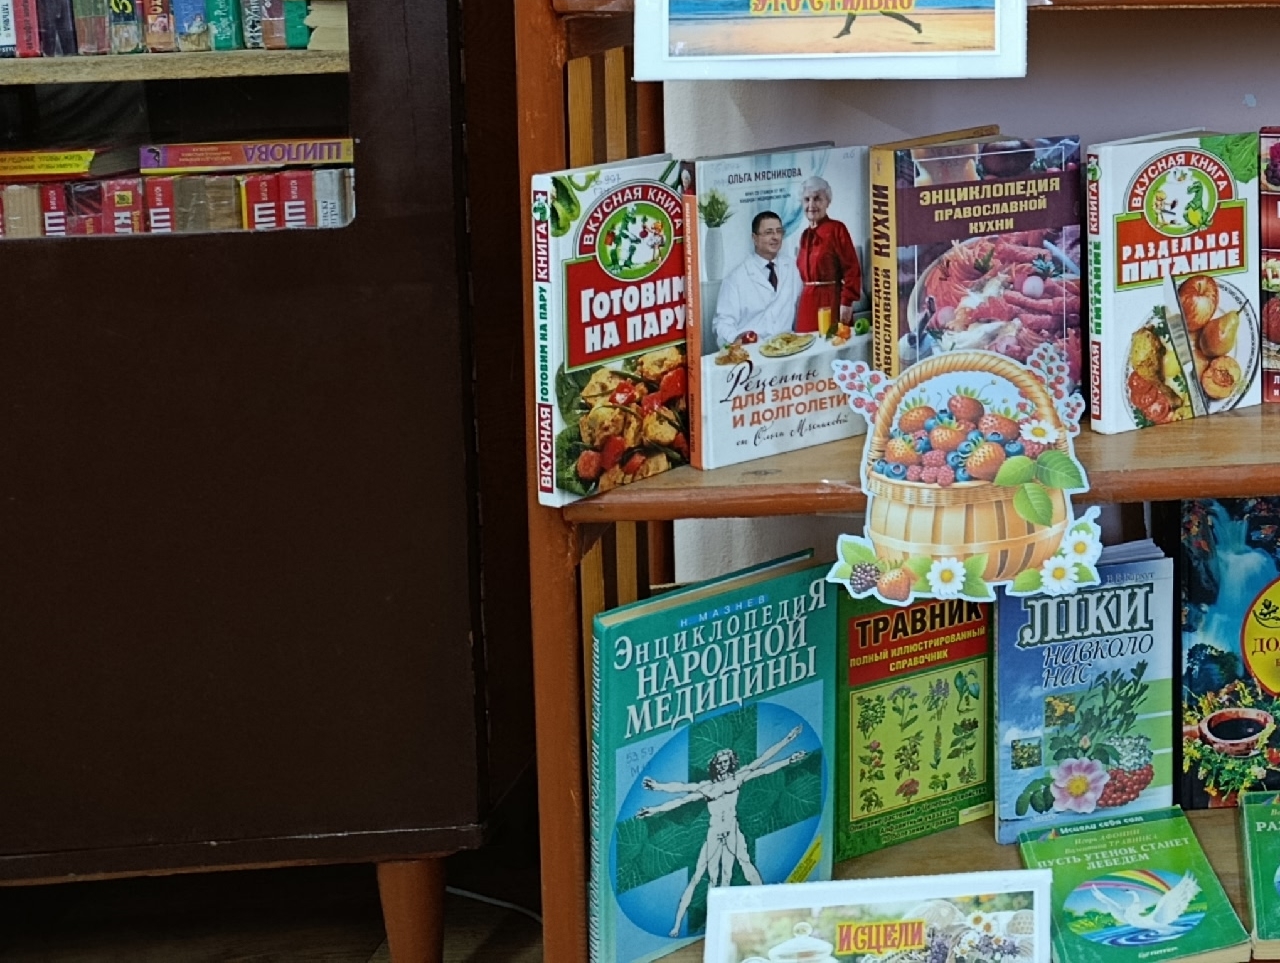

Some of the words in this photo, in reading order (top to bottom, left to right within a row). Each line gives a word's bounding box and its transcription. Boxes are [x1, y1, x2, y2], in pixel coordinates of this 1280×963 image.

[244, 142, 342, 163] ШИЛОВА
[919, 177, 1060, 206] ЭНЦИКЛОПЕДИЯ
[1131, 151, 1188, 208] ВКУСНАЯ
[1190, 152, 1228, 193] КНИГА
[872, 184, 891, 258] КУХНИ
[934, 196, 1047, 223] ПРАВОСЛАВНОЙ
[1089, 182, 1098, 233] КНИГА
[969, 218, 1014, 234] КУХНИ
[535, 224, 548, 280] КНИГА
[1122, 231, 1240, 260] РАЗДЕЛЬНОЕ
[1122, 250, 1240, 283] ПИТАНИЕ
[580, 275, 686, 324] ГОТОВИМ
[584, 321, 621, 354] НА
[627, 305, 686, 342] ПАРУ
[539, 343, 549, 402] ГОТОВИМ
[1091, 343, 1100, 417] ВКУСНАЯ
[731, 392, 765, 412] ДЛЯ
[539, 406, 552, 488] ВКУСНАЯ
[613, 577, 827, 670] ЭНЦИКЛОПЕДИЯ
[699, 594, 767, 622] МАЗНЕВ
[855, 598, 983, 649] ТРАВНИК
[636, 616, 808, 699] НАРОДНОЙ
[891, 626, 985, 658] ИЛЛЮСТРИРОВАННЫЙ
[1043, 634, 1154, 668] навколо
[889, 649, 948, 672] СПРАВОЧНИК
[1043, 664, 1092, 687] нас
[625, 645, 817, 739] МЕДИЦИНЫ
[1085, 846, 1136, 862] УТЕНОК
[837, 920, 924, 952] ИСЦЕЛИ
